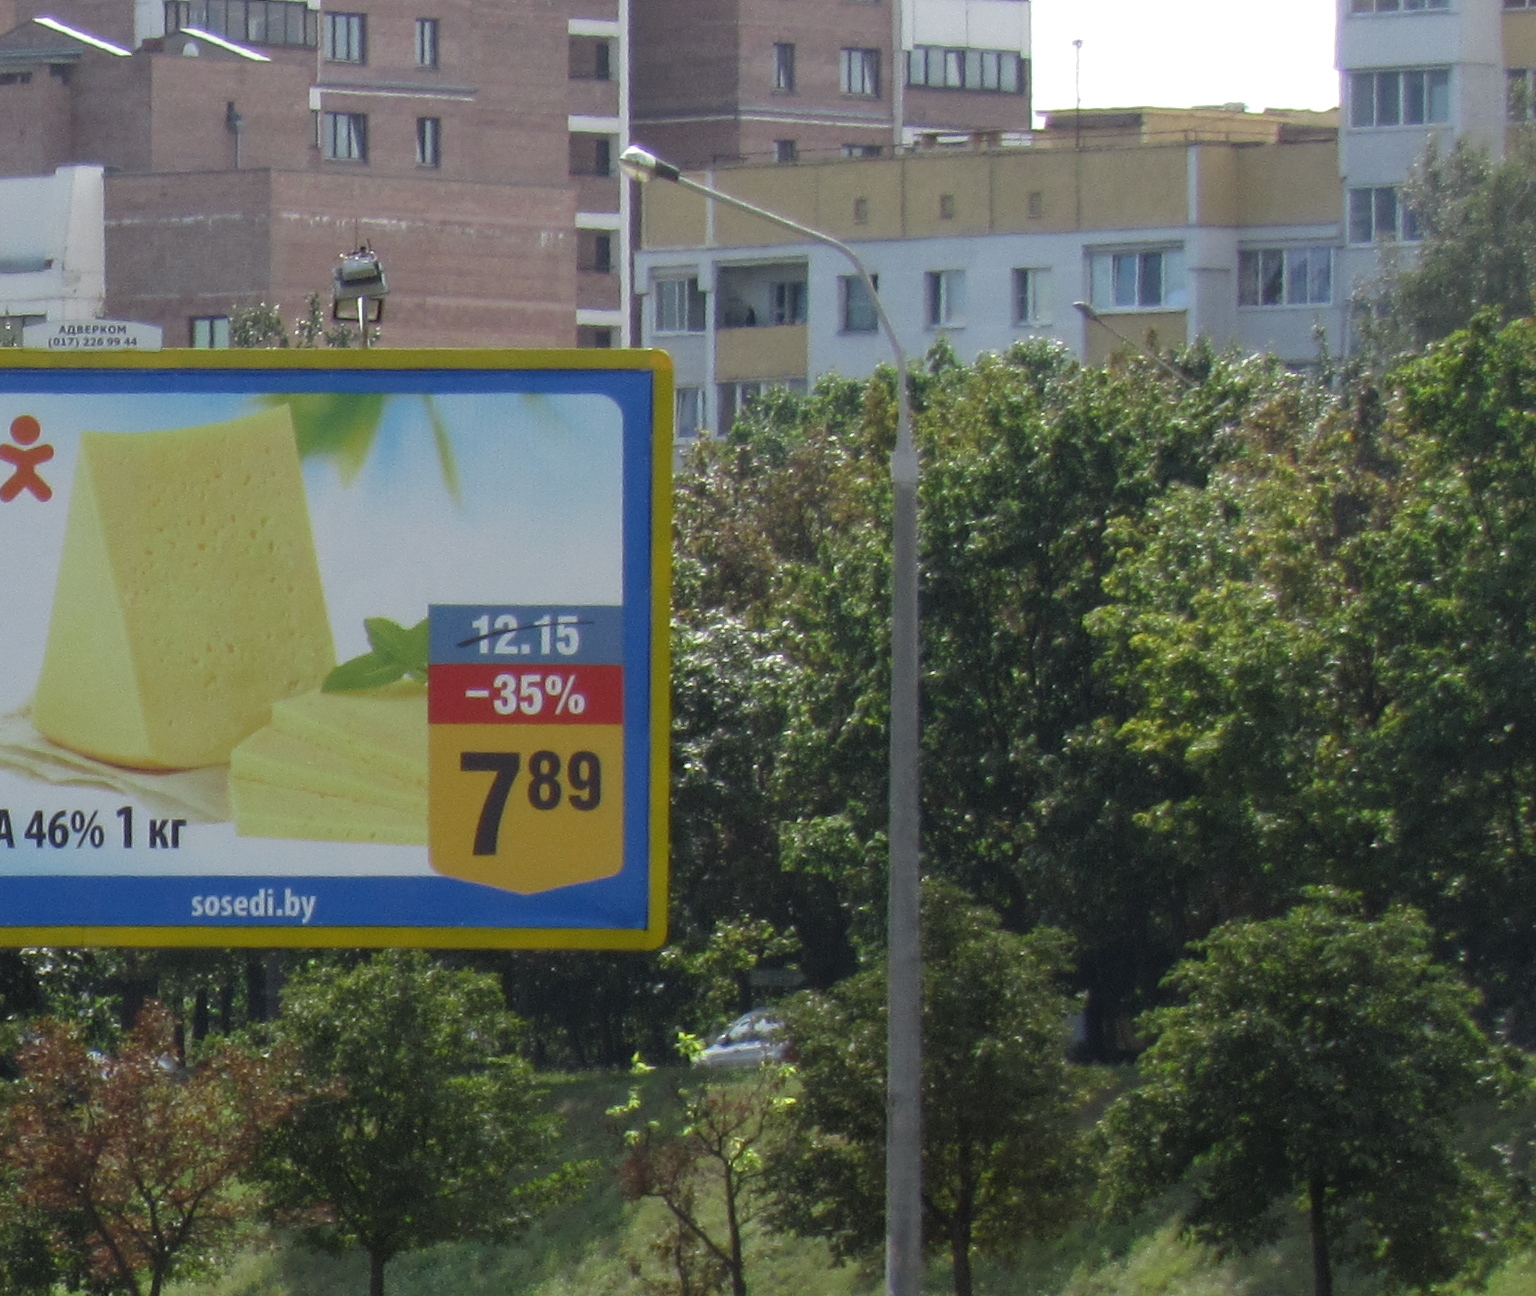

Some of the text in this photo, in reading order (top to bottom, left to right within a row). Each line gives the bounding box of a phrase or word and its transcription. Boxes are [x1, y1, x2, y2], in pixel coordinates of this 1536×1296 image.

[48, 337, 137, 348] (017) 226 99 44
[59, 325, 127, 335] АДВЕРКОМ
[472, 615, 579, 655] 12.15
[25, 809, 104, 849] 46%
[116, 806, 134, 848] 1
[149, 818, 186, 849] кг
[192, 889, 316, 923] sosedi.by
